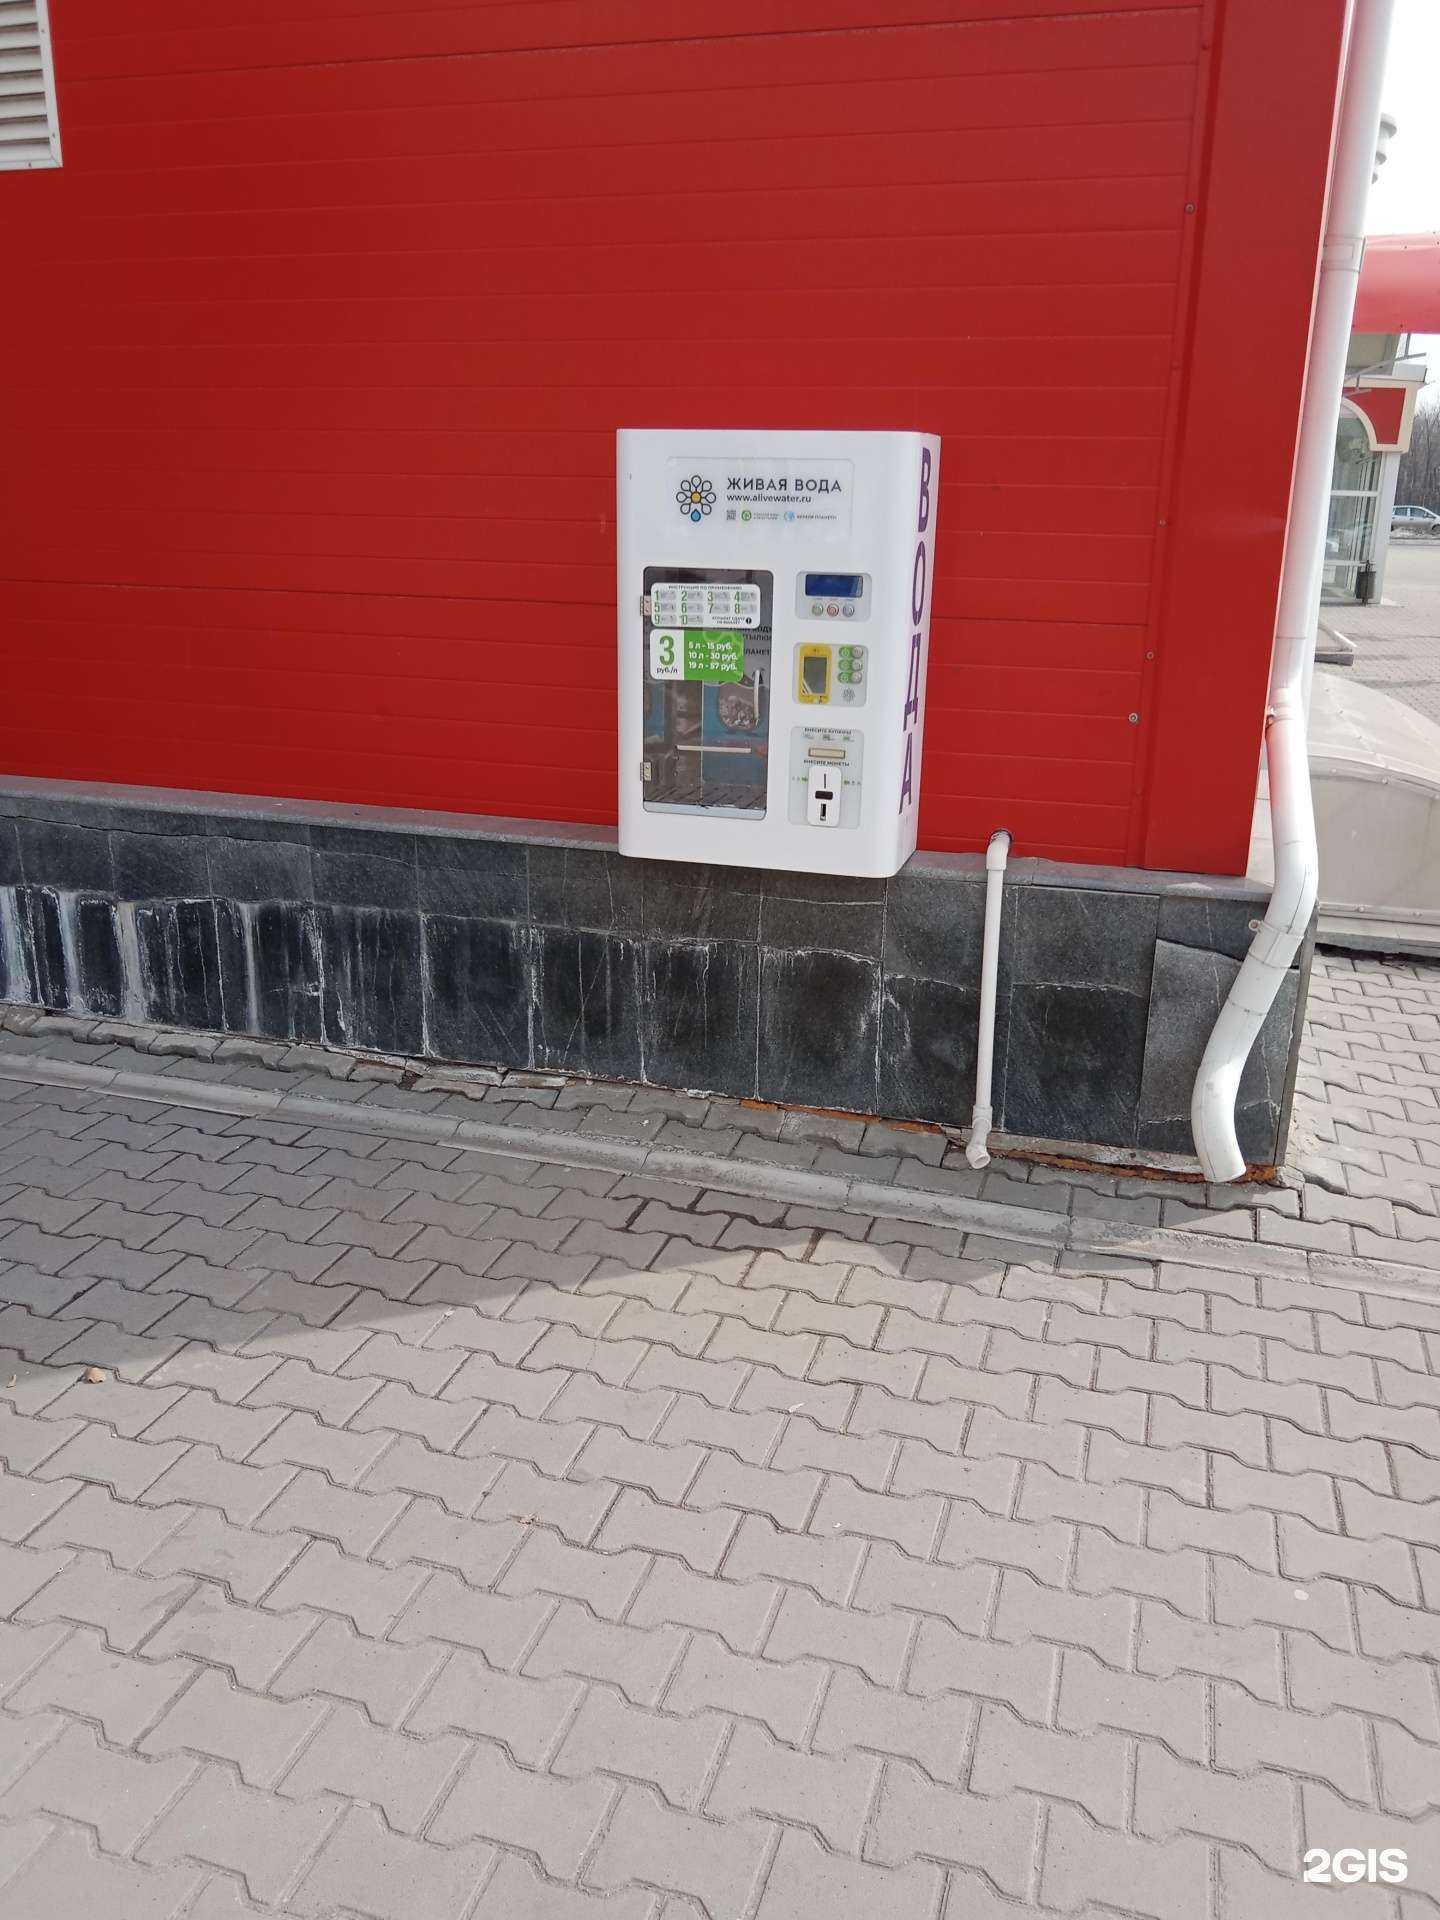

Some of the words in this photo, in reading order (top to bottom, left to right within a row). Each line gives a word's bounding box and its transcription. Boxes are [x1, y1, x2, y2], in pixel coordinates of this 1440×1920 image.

[727, 477, 787, 491] ЖИВАЯ
[795, 479, 842, 493] ВОДА
[727, 493, 811, 503] www.alivewater.ru
[681, 591, 688, 601] 2
[707, 591, 714, 601] 3
[734, 591, 740, 602] 4
[654, 602, 660, 612] 5
[681, 602, 688, 613] 6
[708, 603, 714, 614] 7
[899, 447, 931, 815] ВОДА
[659, 635, 675, 666] 3
[707, 641, 715, 649] 15
[716, 642, 733, 651] руб.
[711, 652, 720, 660] 30
[721, 652, 738, 662] руб.
[688, 661, 697, 669] 19
[721, 662, 738, 672] руб.
